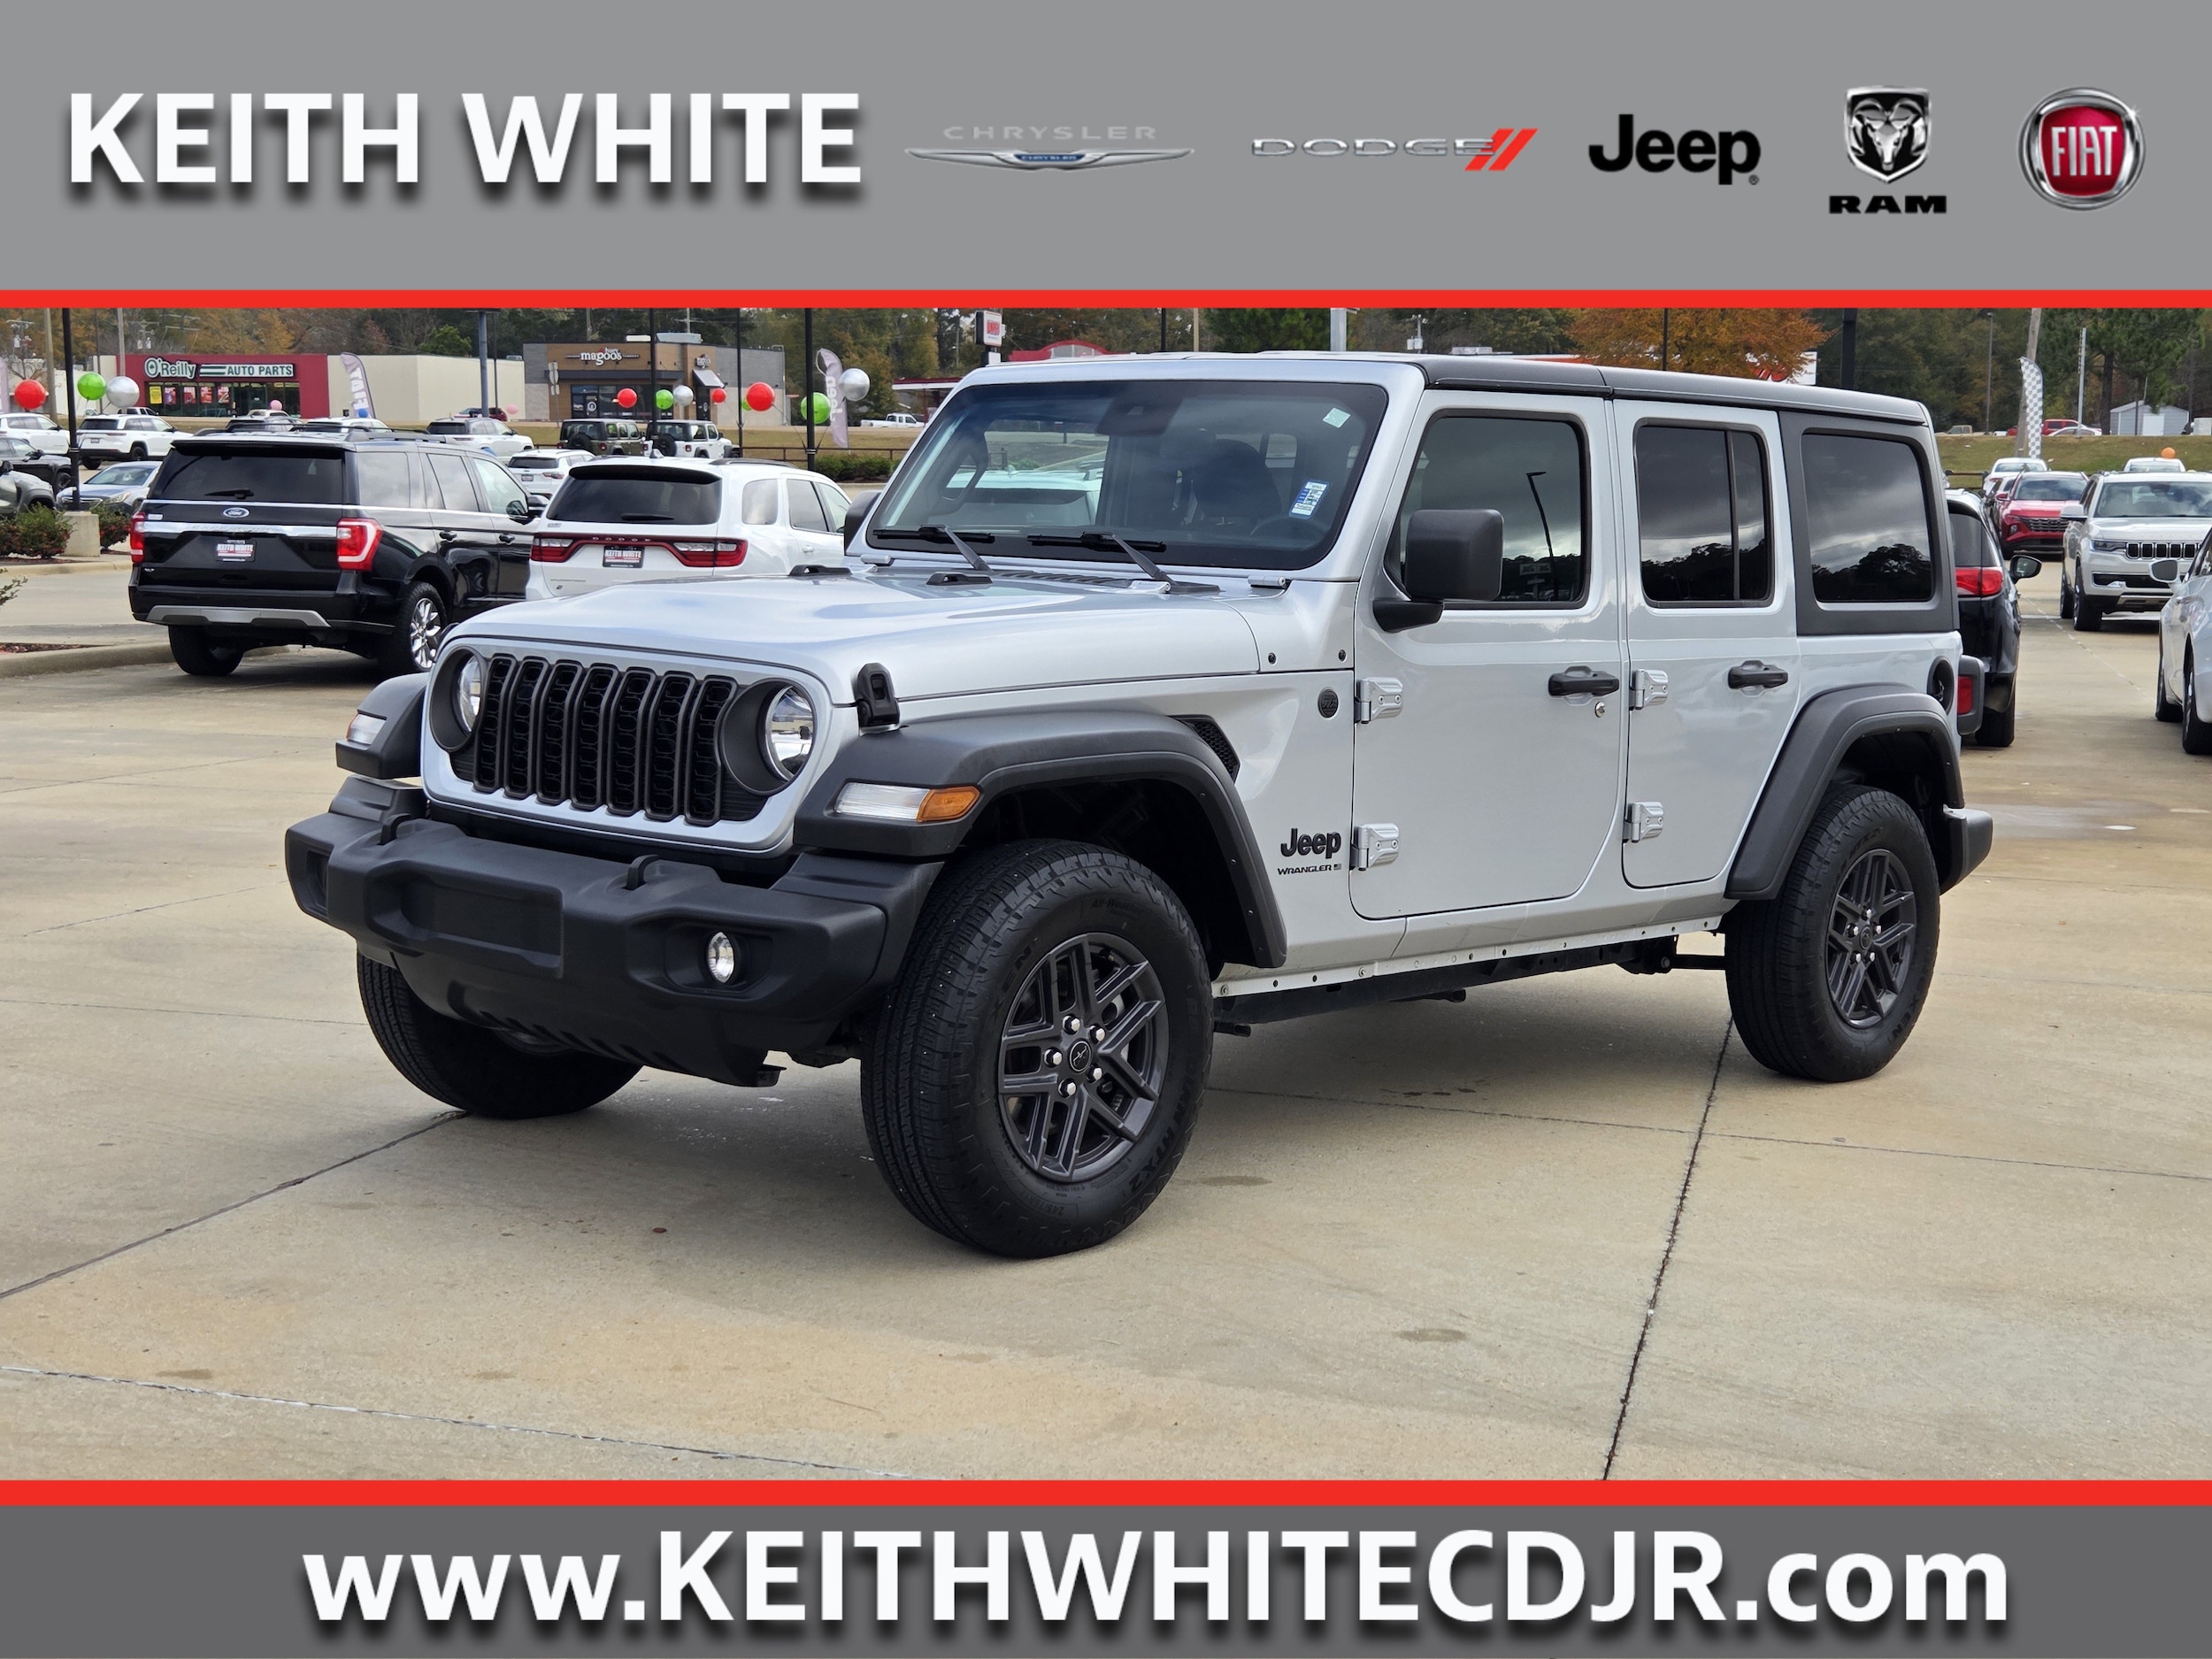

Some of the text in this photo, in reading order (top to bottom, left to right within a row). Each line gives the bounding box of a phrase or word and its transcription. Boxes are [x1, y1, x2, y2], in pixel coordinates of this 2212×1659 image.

[145, 358, 292, 378] O'Reilly AUTO PARTS
[1280, 827, 1341, 859] Jeep
[1277, 864, 1332, 875] WRANGLER
